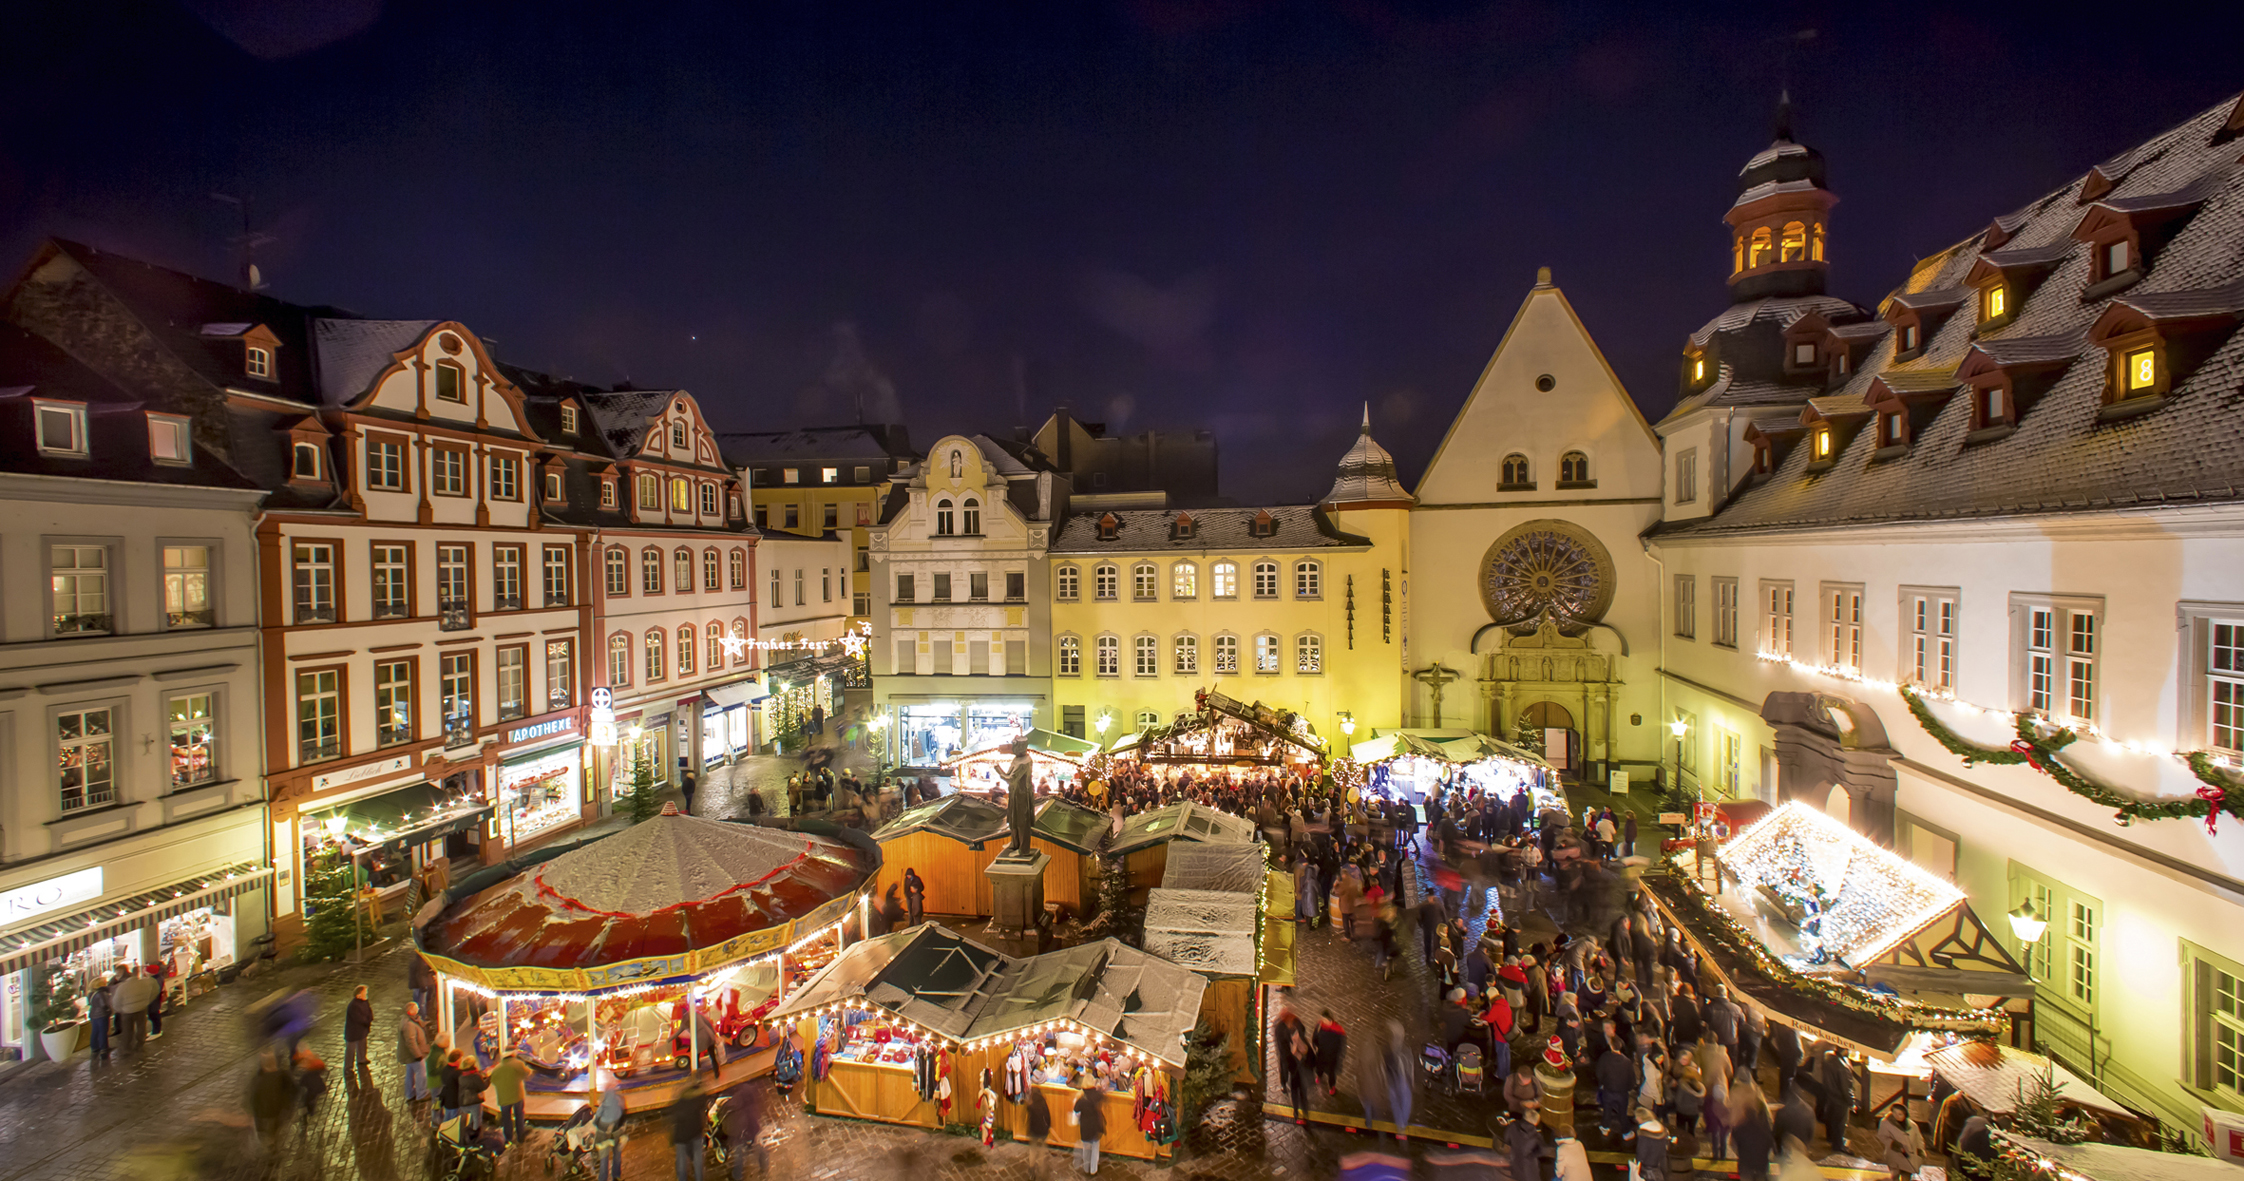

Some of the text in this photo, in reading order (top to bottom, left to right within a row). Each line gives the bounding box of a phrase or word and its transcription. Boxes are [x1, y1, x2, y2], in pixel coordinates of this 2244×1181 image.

[2139, 358, 2153, 382] 8
[747, 637, 829, 650] Frohes Fest
[513, 717, 572, 743] APOTHEKE
[1791, 1019, 1856, 1050] Reibekuchen
